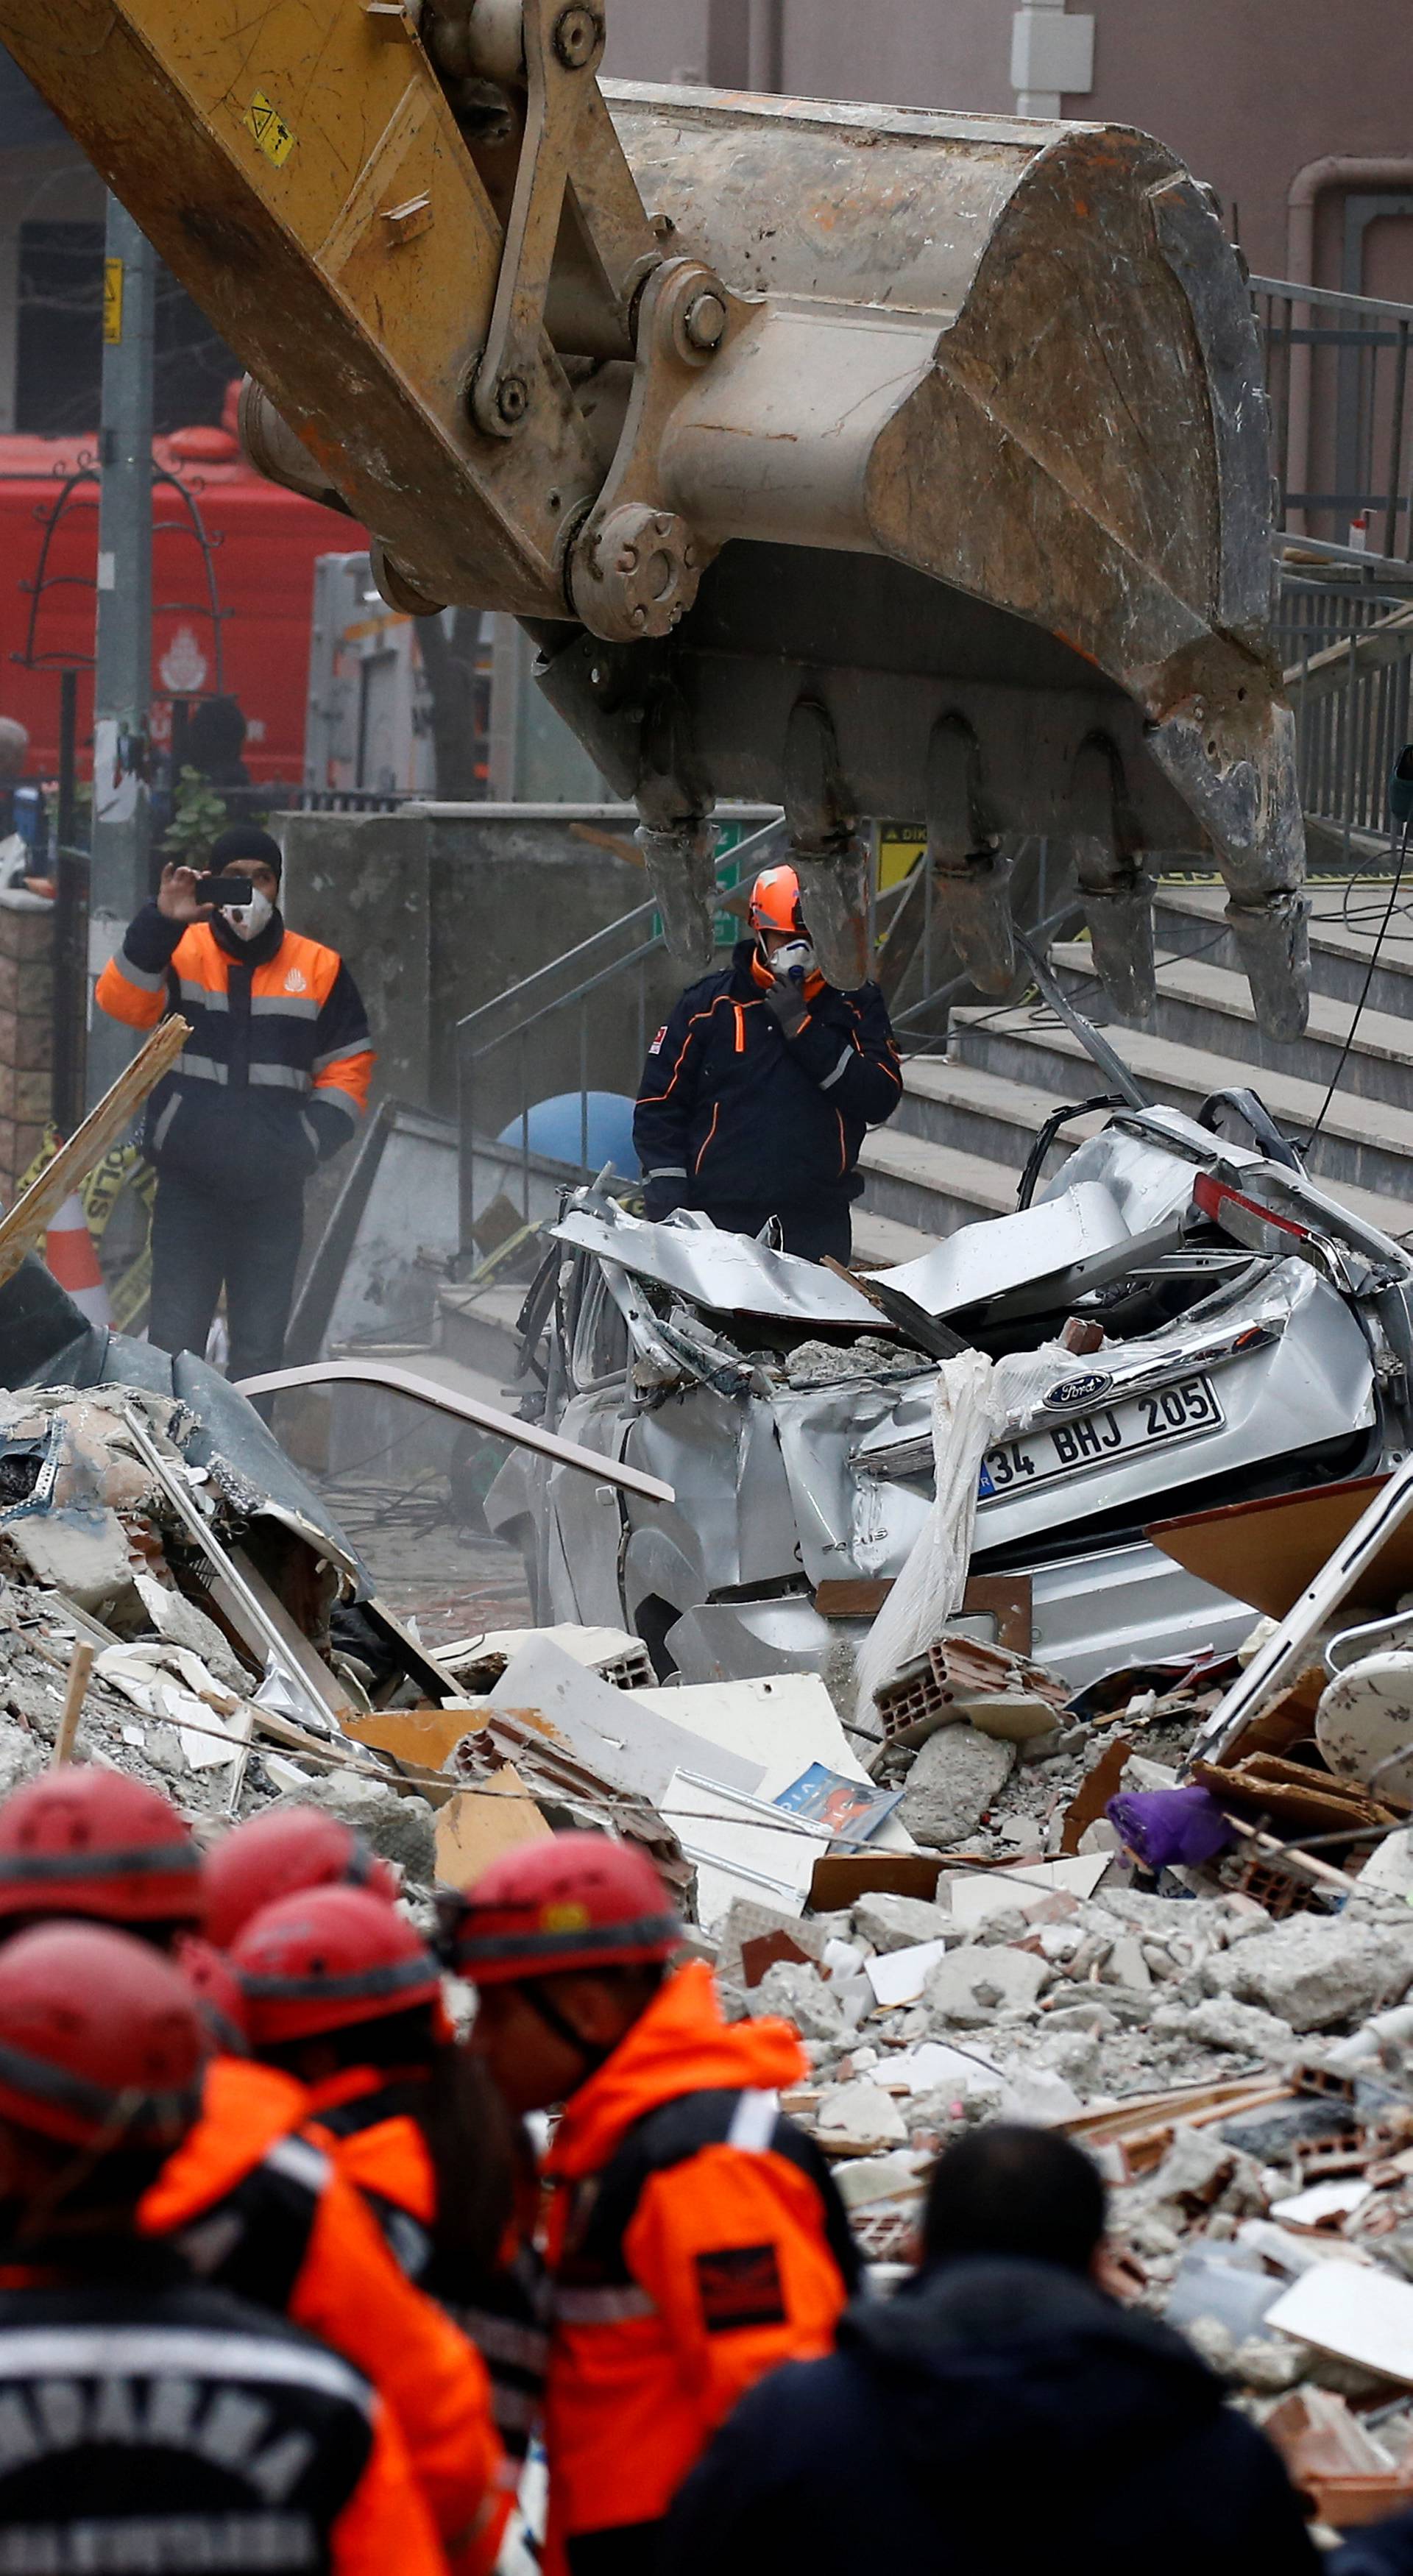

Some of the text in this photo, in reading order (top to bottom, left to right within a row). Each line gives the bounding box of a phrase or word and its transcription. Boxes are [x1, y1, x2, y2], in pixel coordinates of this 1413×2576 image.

[903, 826, 927, 840] DİK
[87, 1150, 124, 1218] OLIS
[1060, 1377, 1102, 1401] Ford
[988, 1381, 1209, 1485] 34 BHJ 205
[980, 1476, 991, 1487] R
[821, 1528, 888, 1555] FOUS
